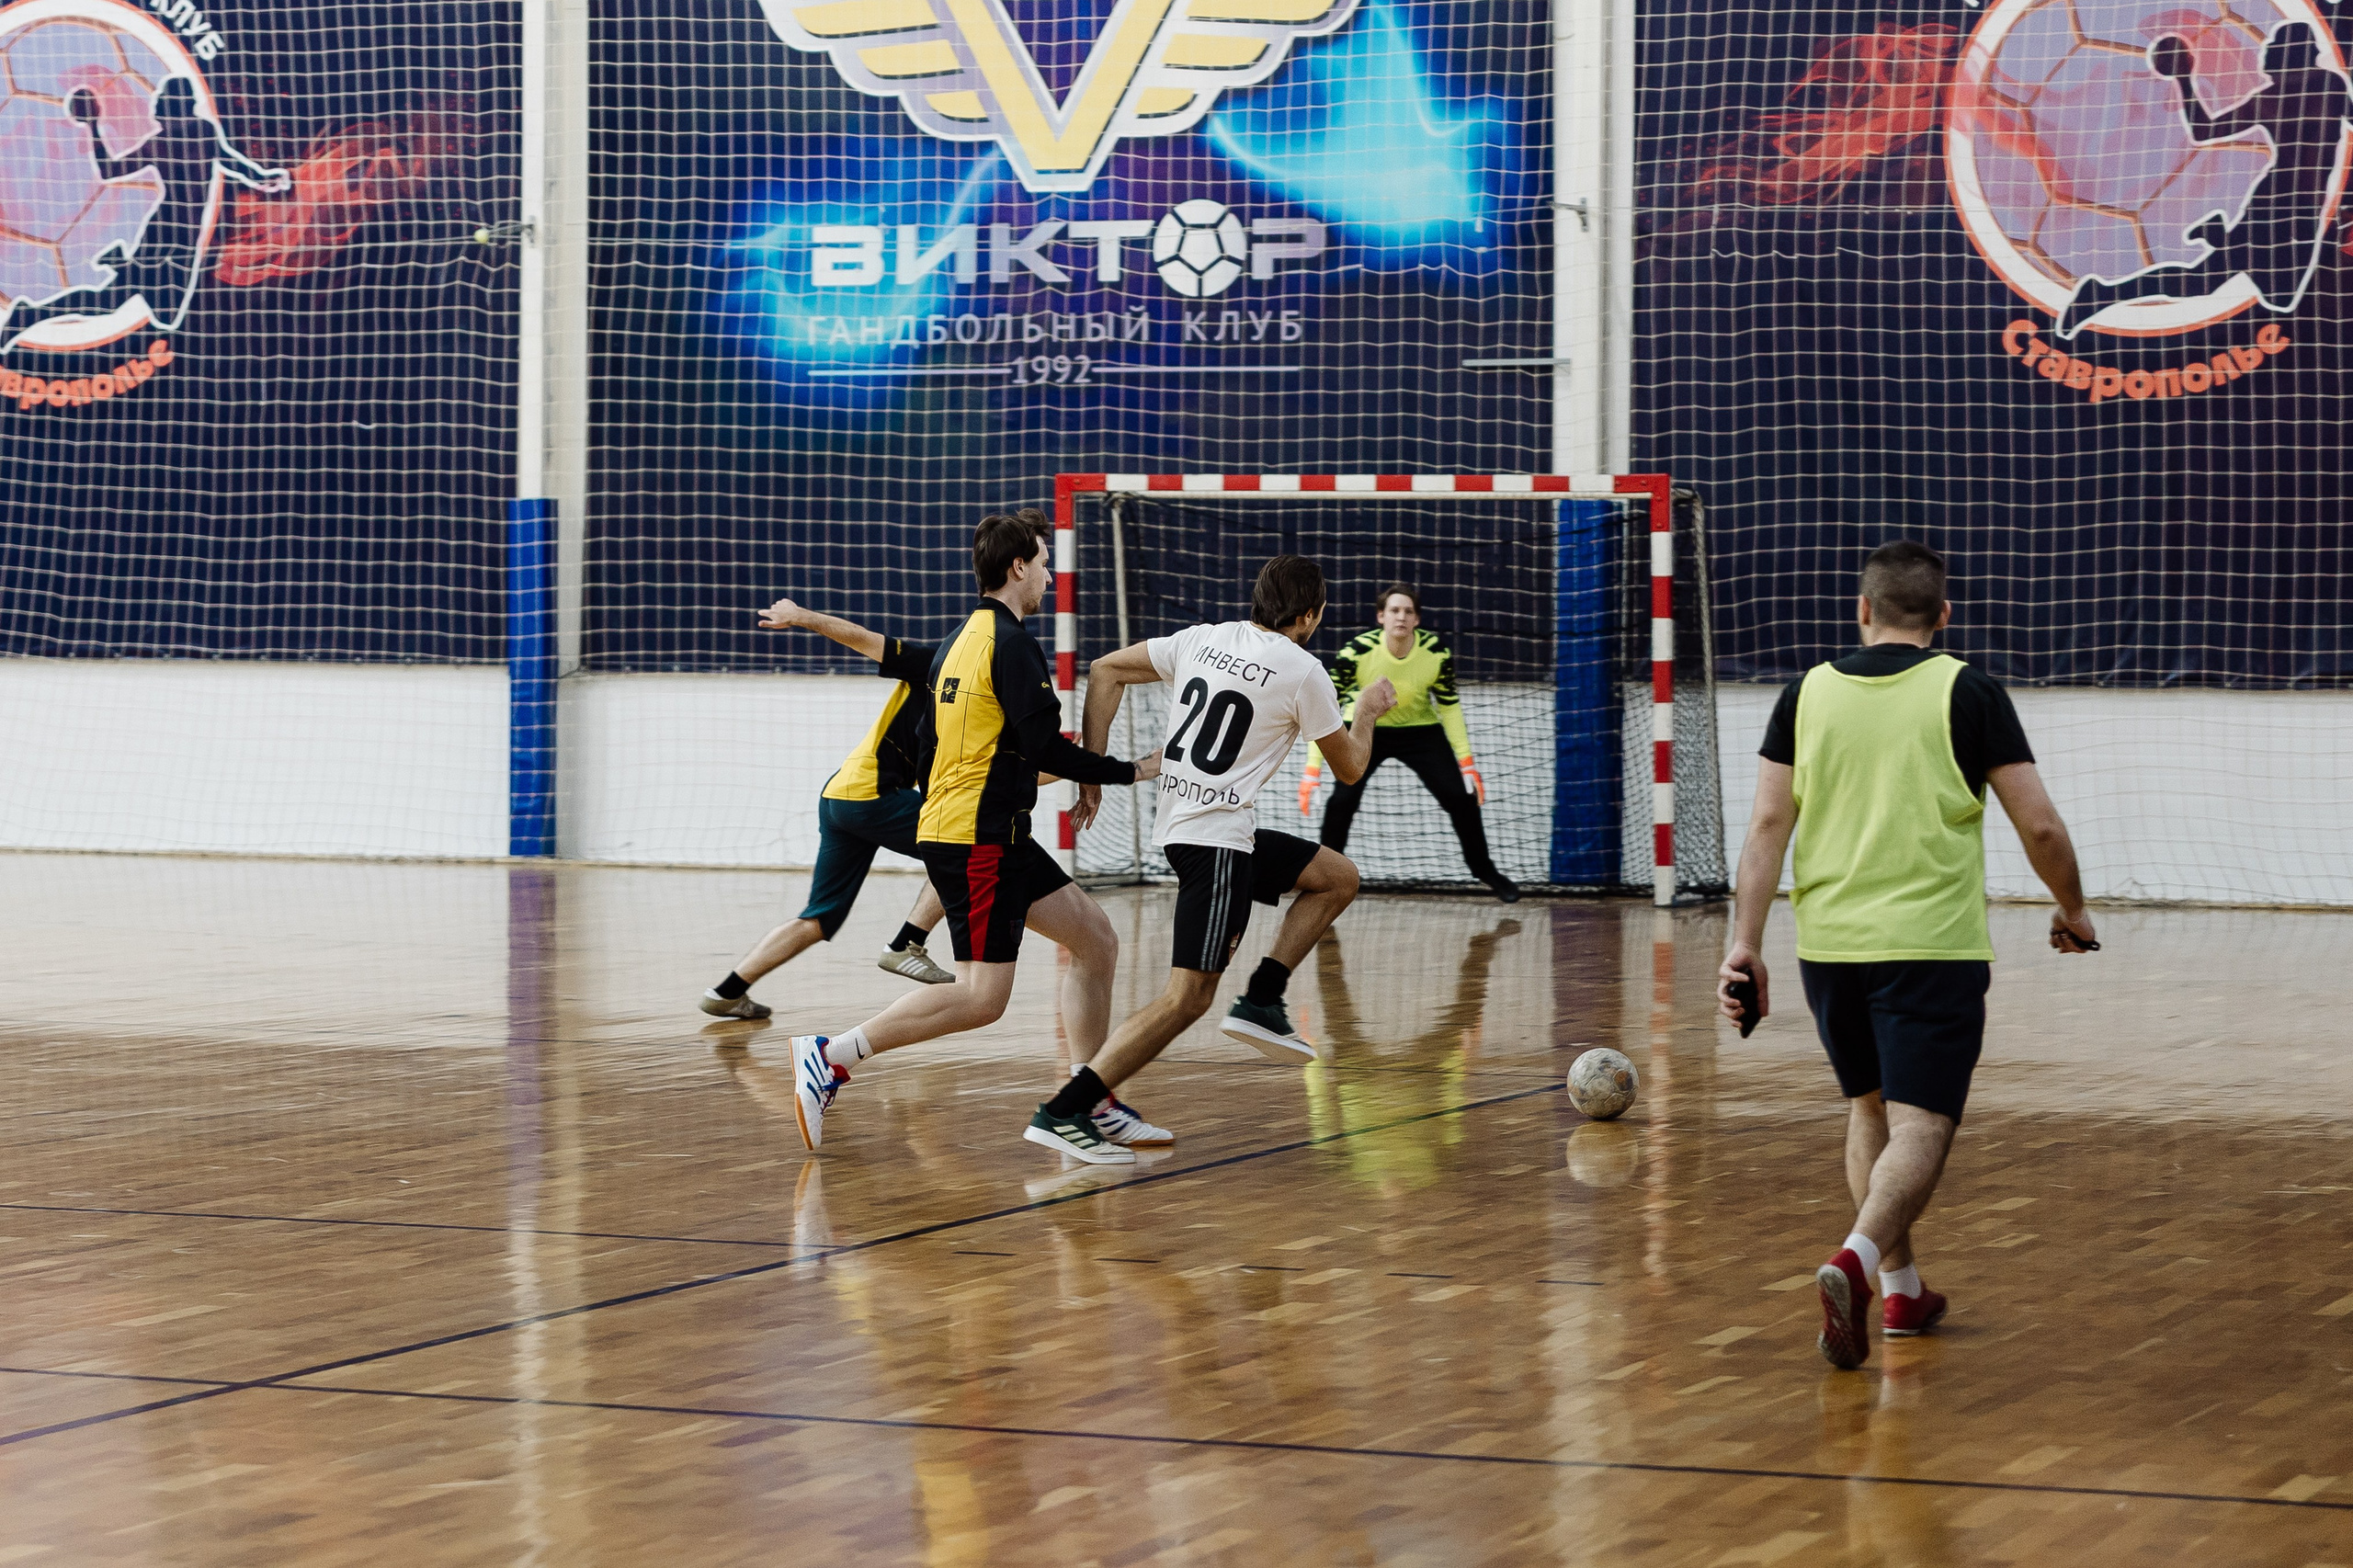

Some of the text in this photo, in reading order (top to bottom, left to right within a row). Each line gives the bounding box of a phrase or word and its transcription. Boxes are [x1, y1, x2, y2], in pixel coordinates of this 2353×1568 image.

[812, 199, 1325, 297] ВИКТОР
[808, 305, 1303, 350] ГАНДБОЛЬНЫЙ КЛУБ
[2002, 319, 2291, 404] Ставрополье
[0, 338, 176, 411] врополье
[1011, 354, 1093, 384] 1992
[1193, 644, 1278, 688] ИНВЕСТ
[1164, 676, 1255, 776] 20
